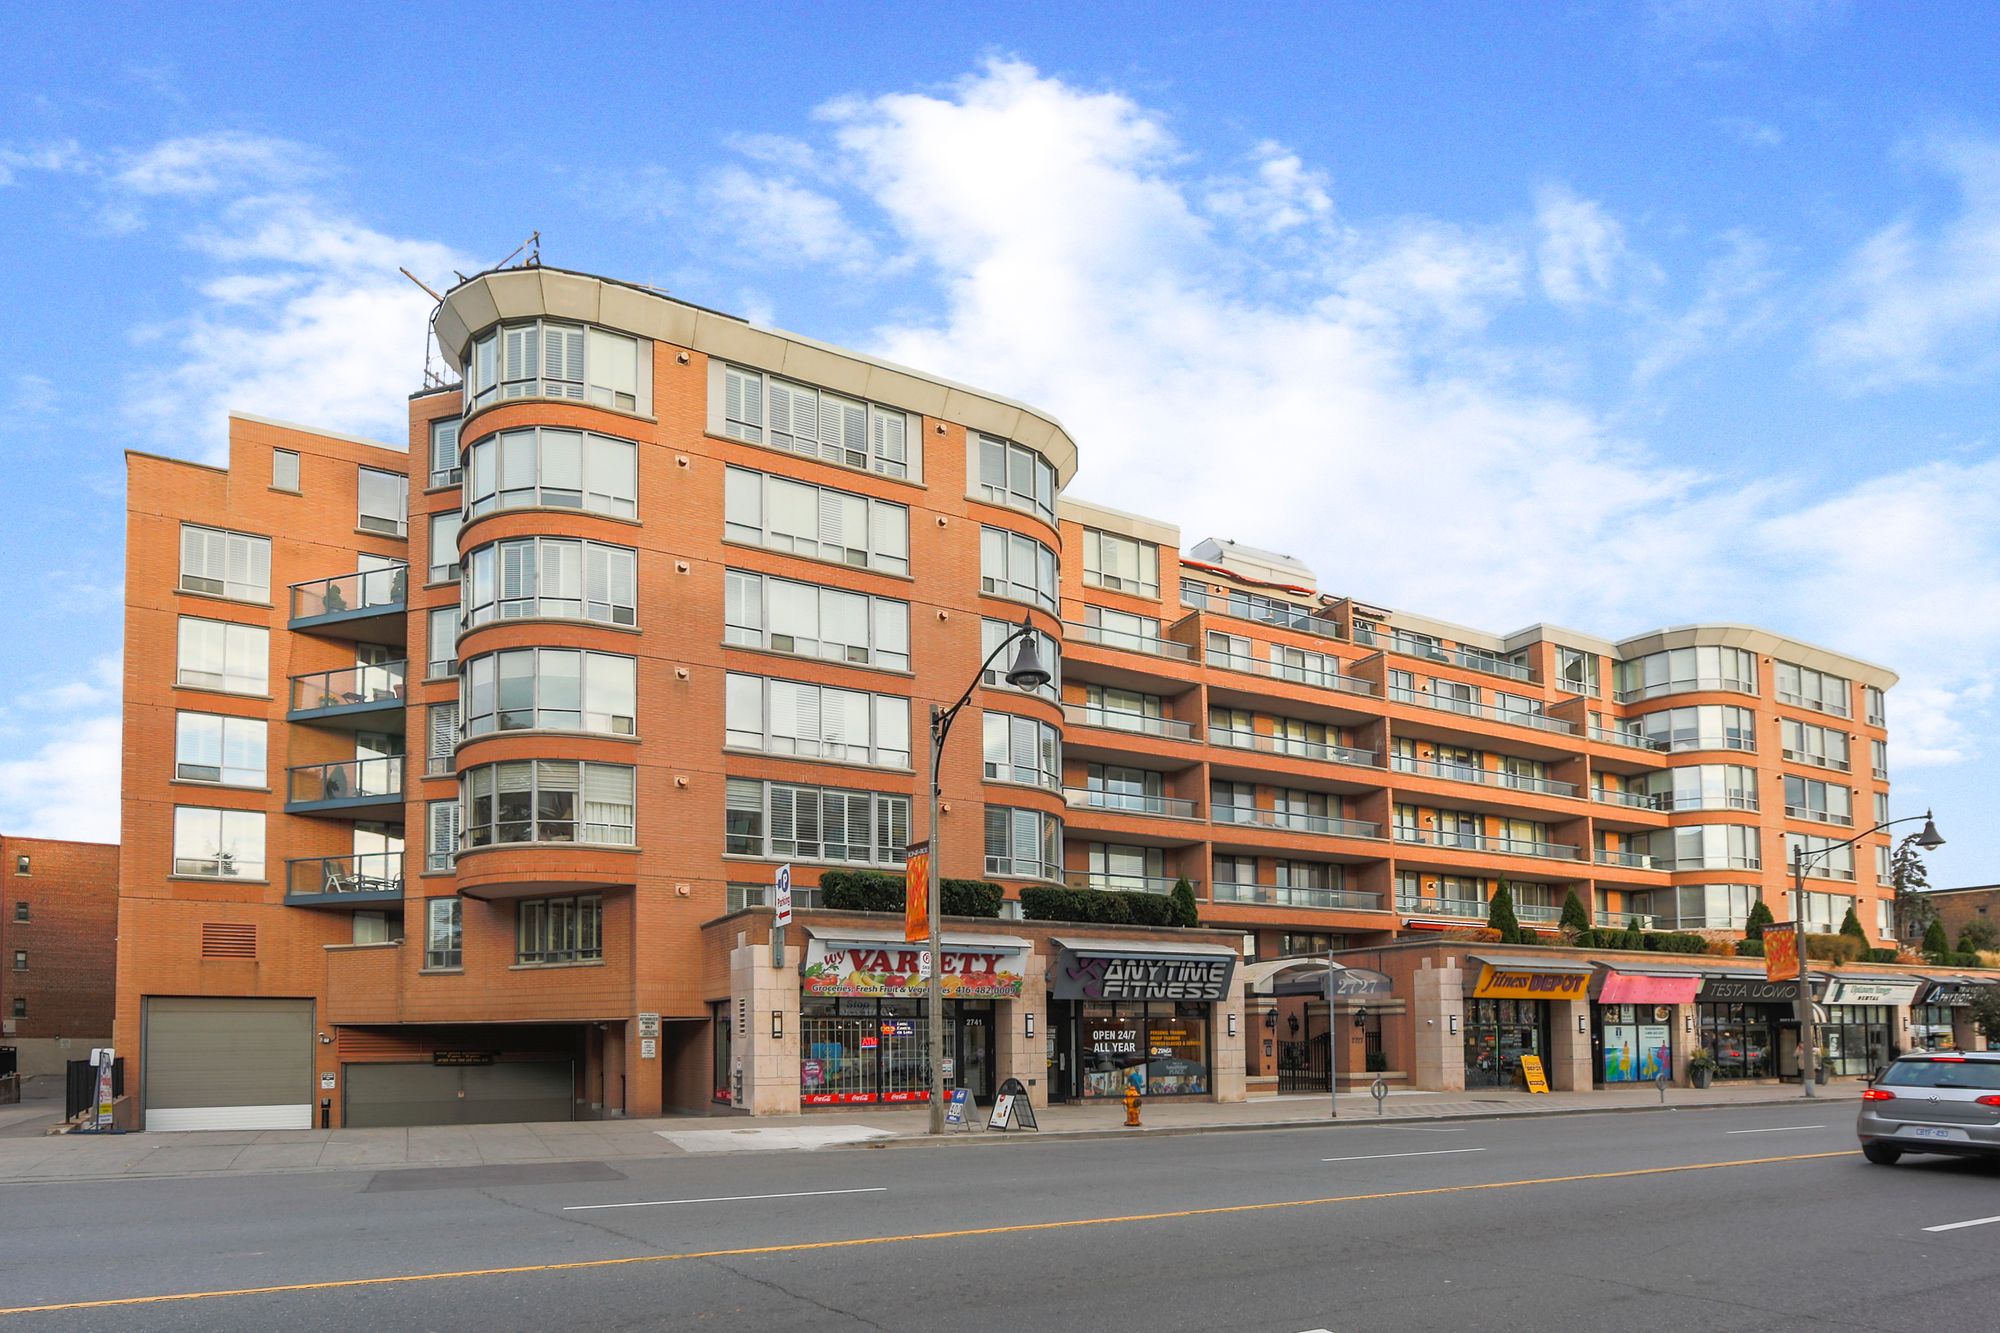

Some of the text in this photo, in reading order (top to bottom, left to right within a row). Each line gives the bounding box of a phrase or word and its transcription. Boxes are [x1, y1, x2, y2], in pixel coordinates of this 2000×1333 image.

[848, 948, 1005, 975] VARETY
[1103, 959, 1227, 982] ANYTIME
[812, 984, 853, 993] Groceries,
[856, 985, 878, 993] Fresh
[880, 985, 898, 993] Fruit
[1102, 981, 1222, 999] FITNESS
[1337, 979, 1378, 994] 2727
[1527, 973, 1585, 993] DEPOT
[1710, 983, 1798, 998] TESTA UOMO
[862, 1037, 878, 1046] ATM
[1092, 1030, 1137, 1040] OPEN 24/7
[1093, 1043, 1136, 1053] ALL YEAR
